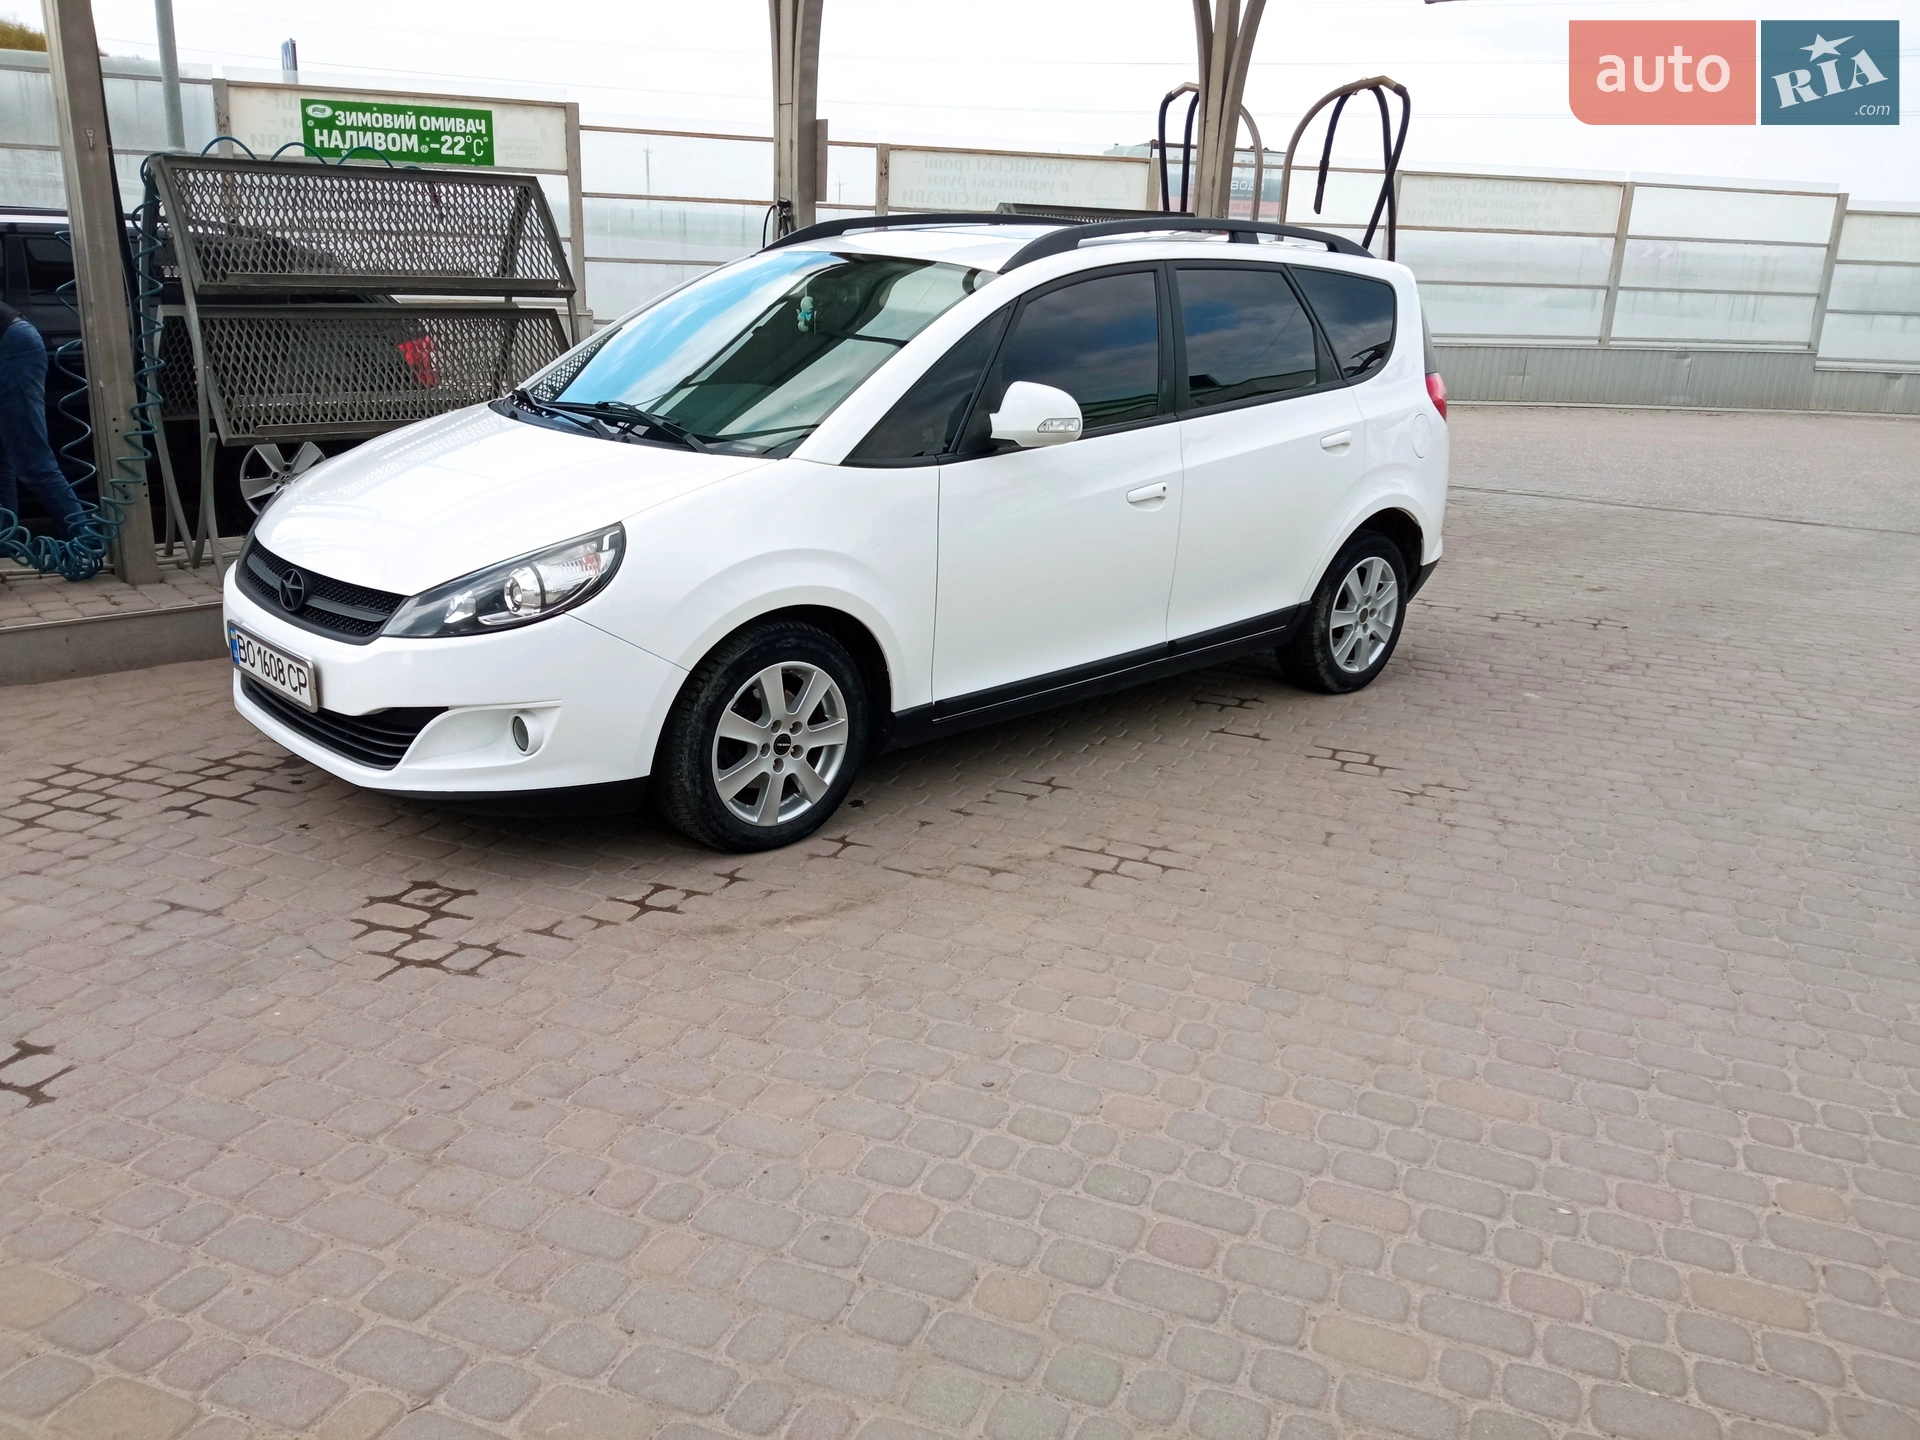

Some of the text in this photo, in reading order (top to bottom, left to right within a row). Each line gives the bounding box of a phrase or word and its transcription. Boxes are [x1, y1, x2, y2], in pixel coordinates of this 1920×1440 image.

[335, 111, 486, 134] ЗИМОВИЙ ОМИВАЧ
[314, 129, 419, 153] НАЛИВОМ
[237, 634, 307, 696] BO 1608 CP
